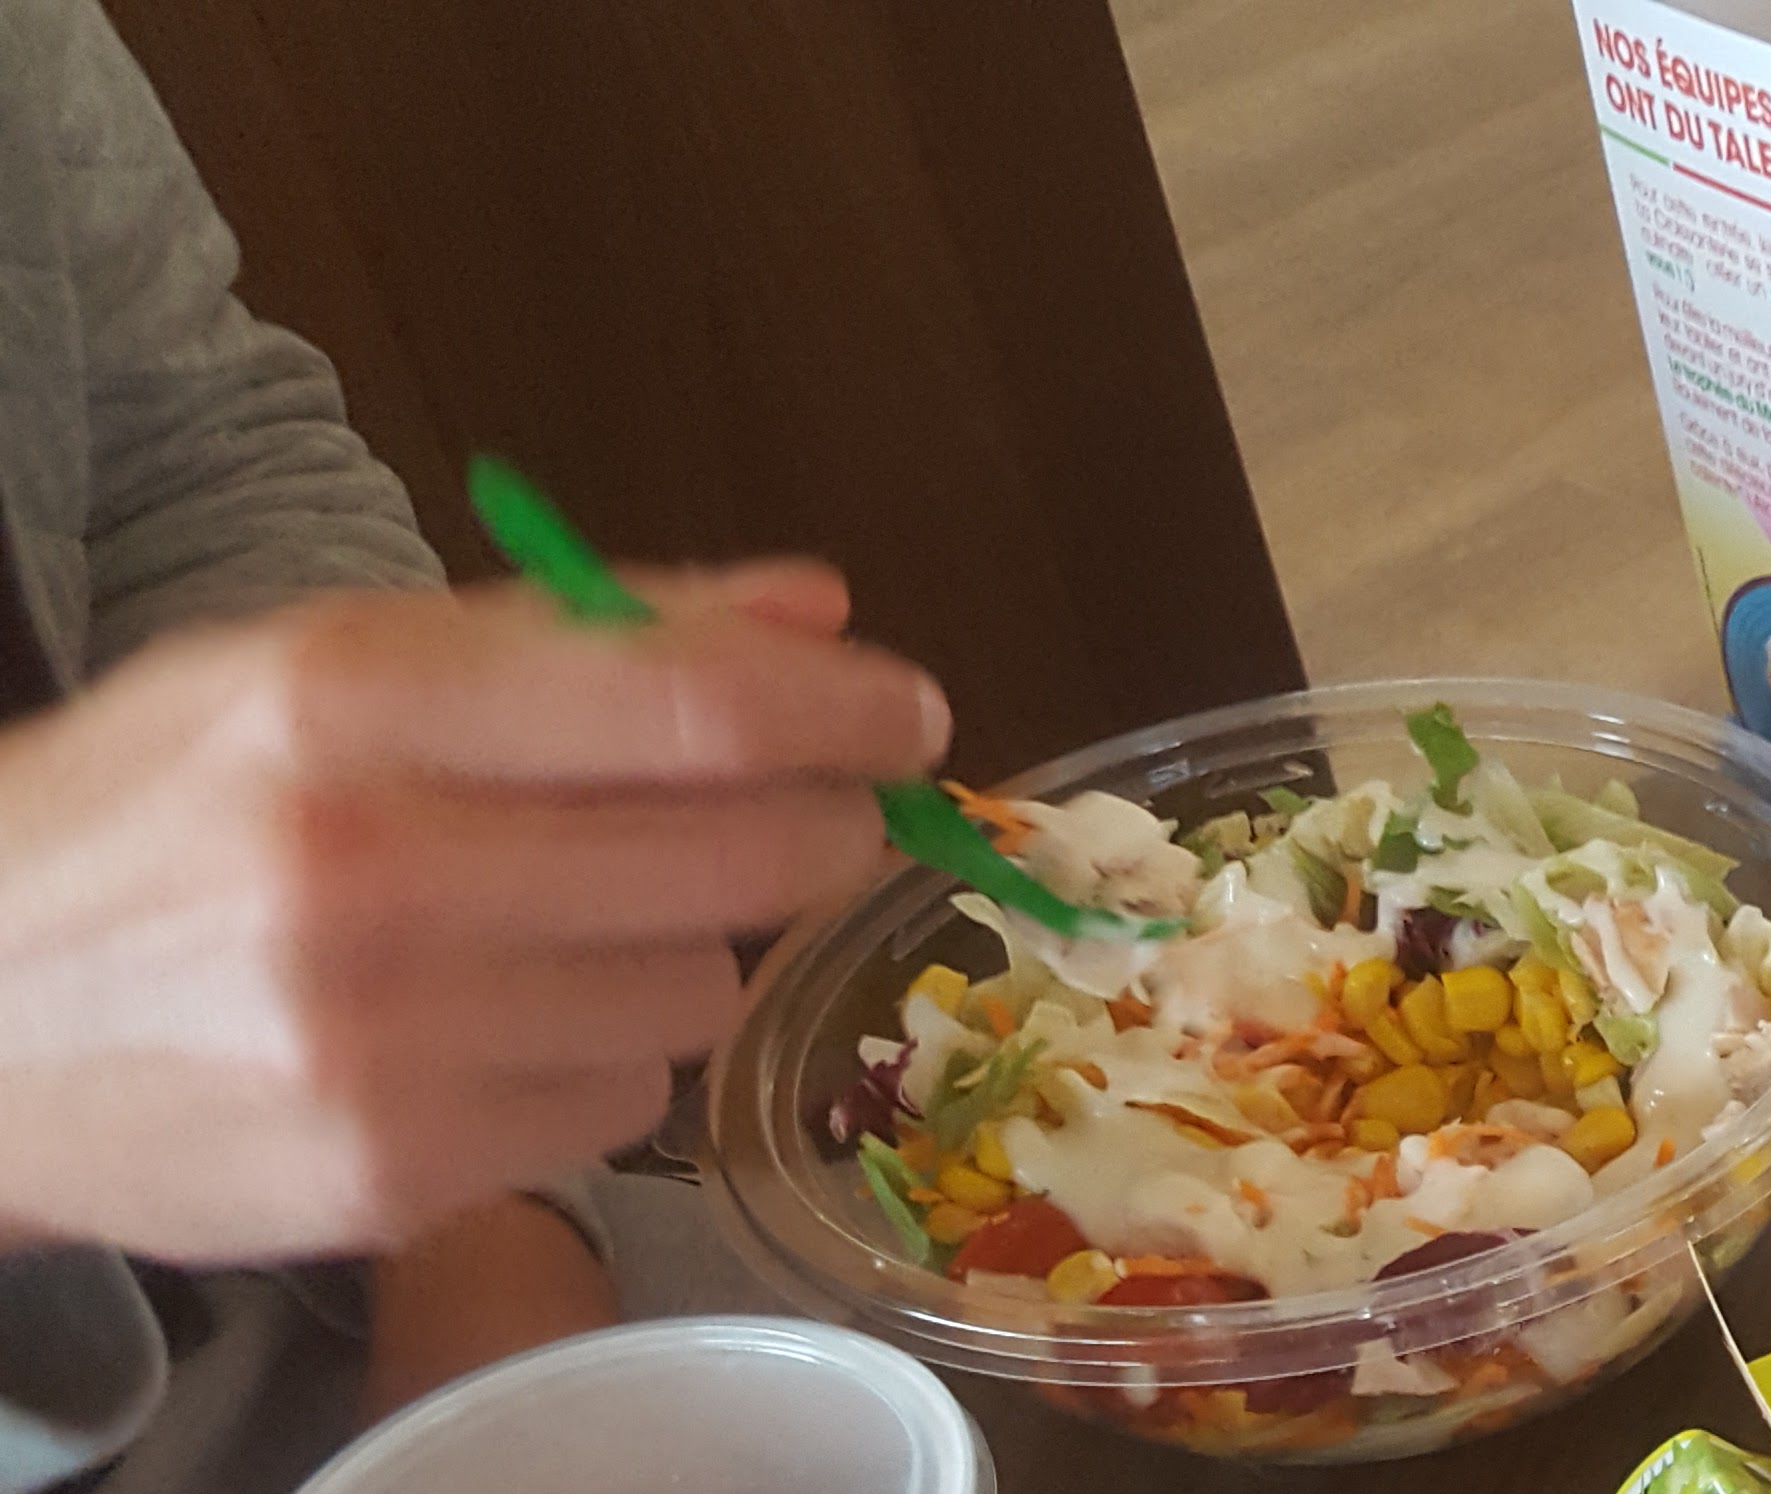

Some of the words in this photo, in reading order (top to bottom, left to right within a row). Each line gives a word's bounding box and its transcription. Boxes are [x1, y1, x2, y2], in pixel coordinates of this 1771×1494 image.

[1593, 18, 1651, 78] NOS
[1606, 73, 1657, 131] ONT
[1664, 100, 1704, 151] DU
